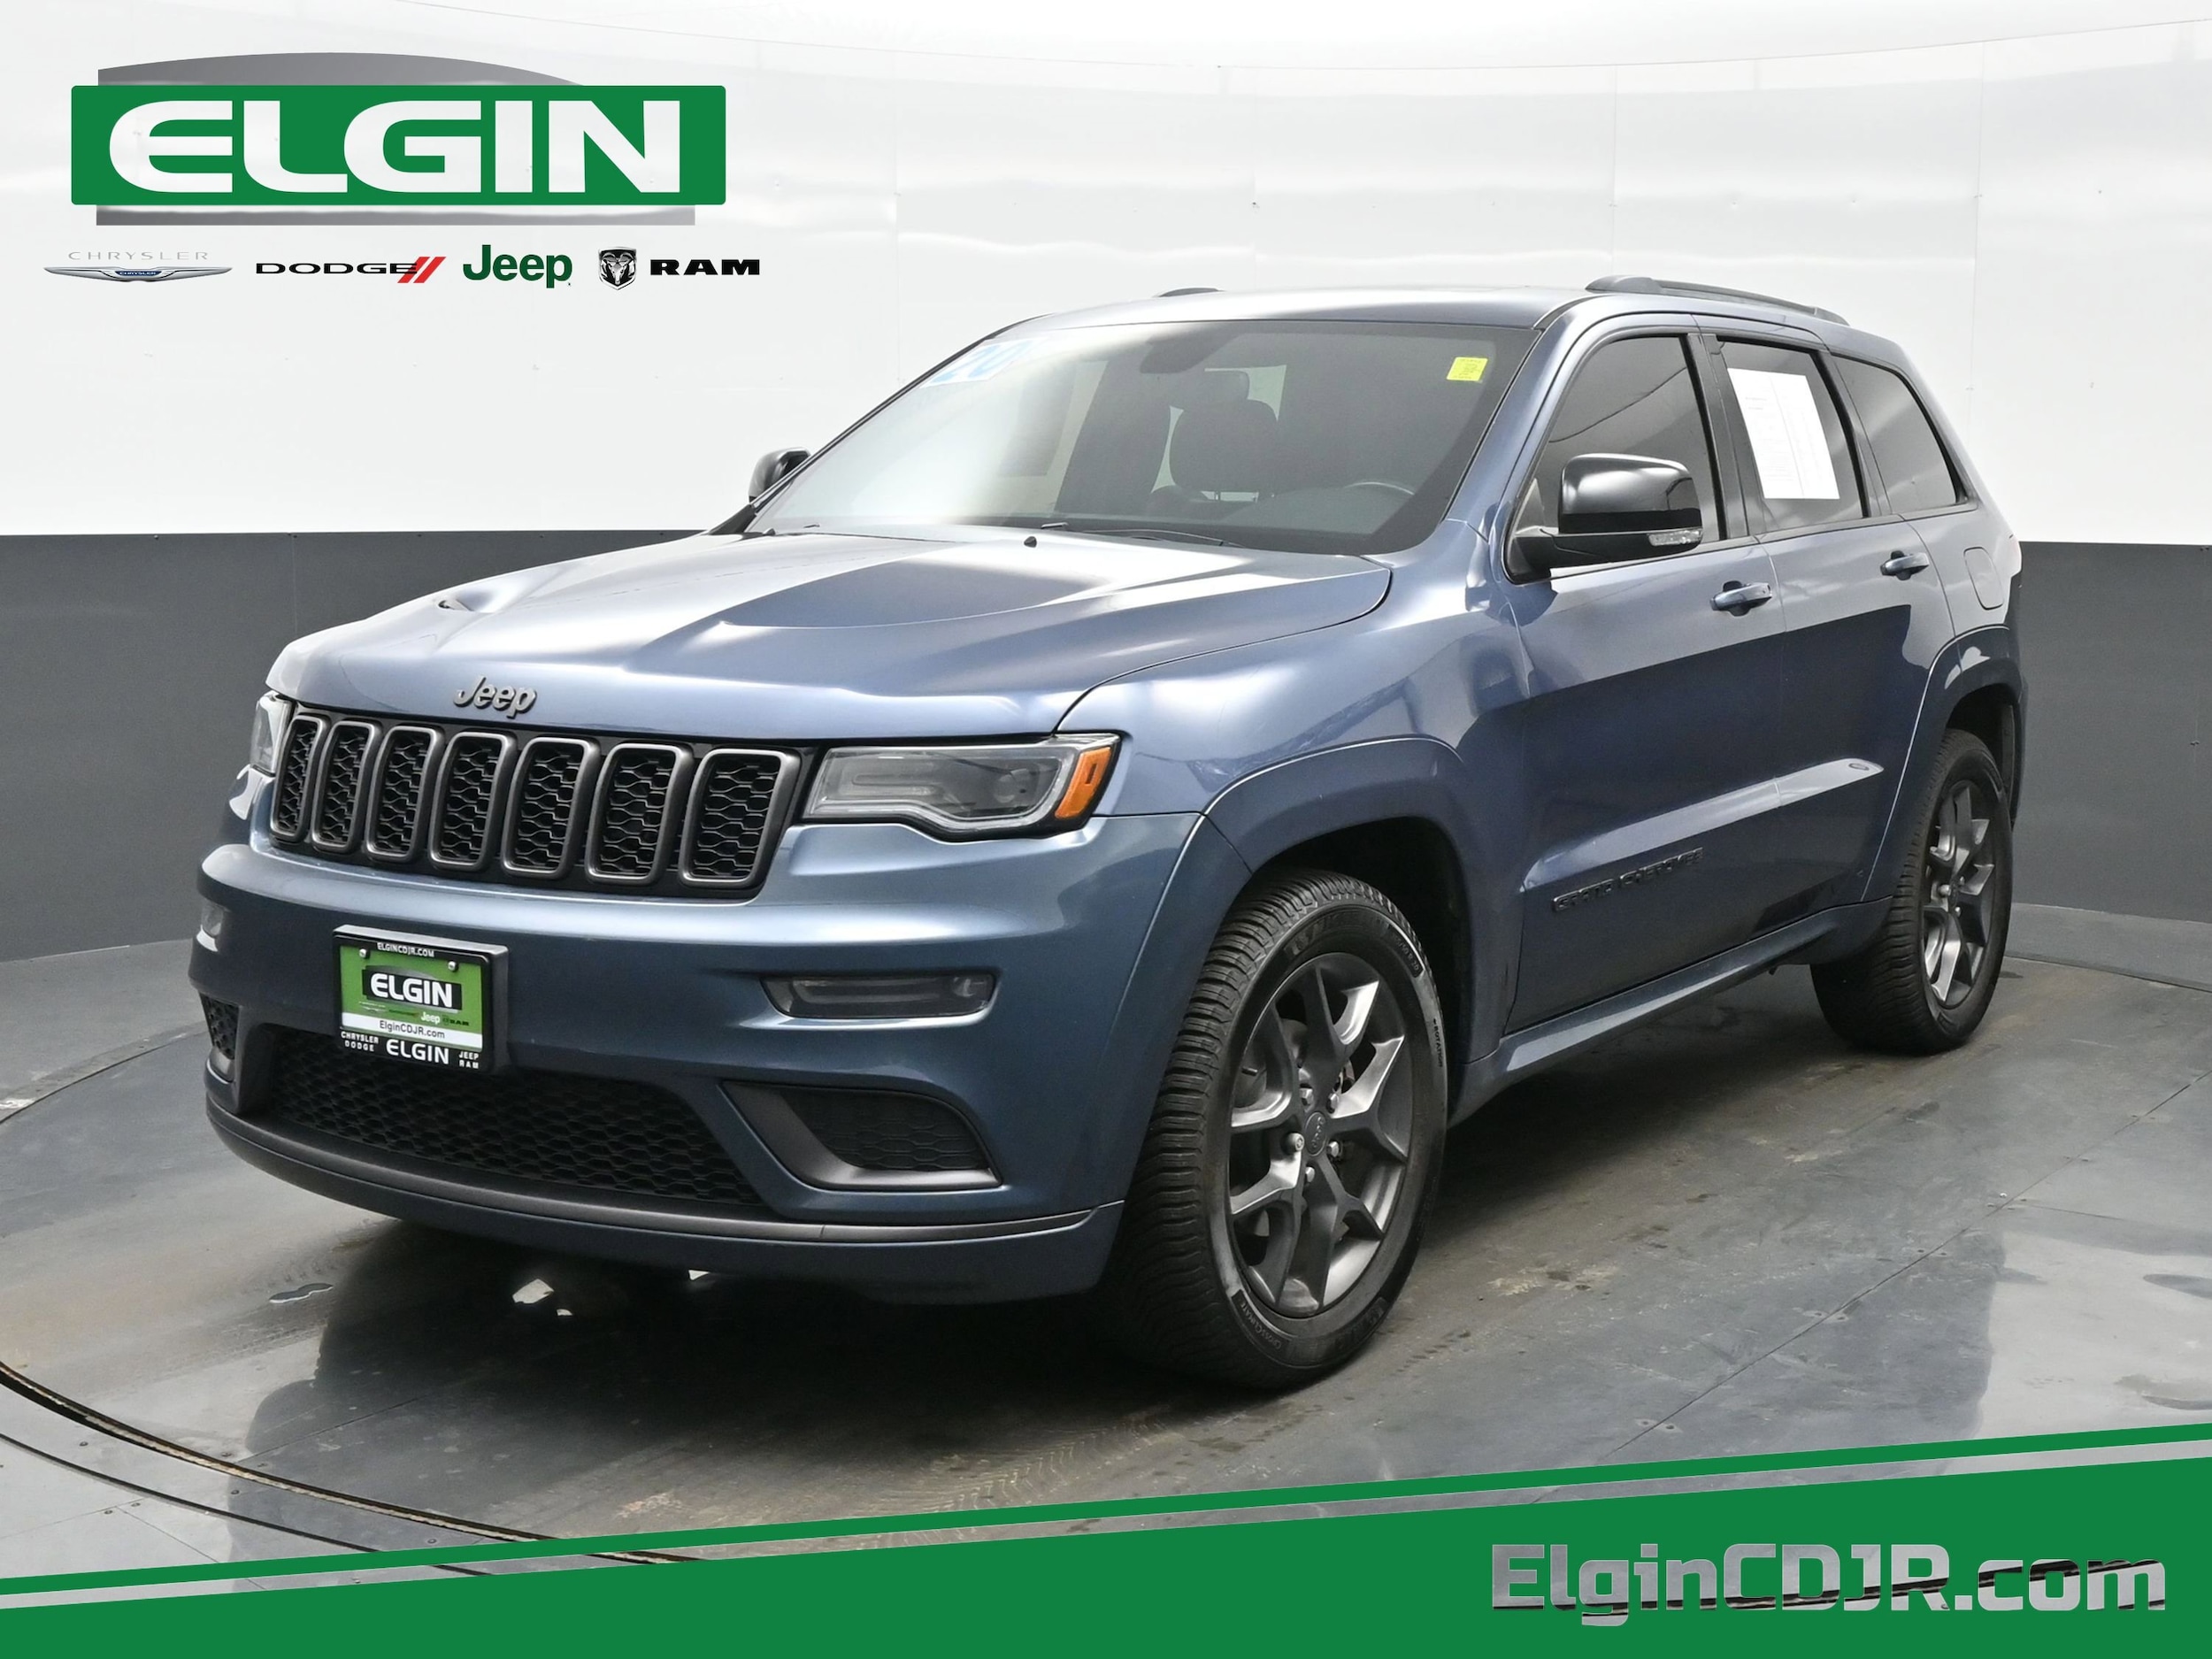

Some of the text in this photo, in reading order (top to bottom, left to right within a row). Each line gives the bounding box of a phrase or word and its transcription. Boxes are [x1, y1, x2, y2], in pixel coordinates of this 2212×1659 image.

[453, 675, 538, 719] Jeep
[377, 941, 435, 957] ELGINCDJR.COM
[370, 972, 453, 1008] ELGIN
[420, 1011, 441, 1025] Jeep
[341, 1030, 379, 1044] CHRYSLER
[380, 1019, 445, 1040] ElginCDJR.com
[344, 1041, 375, 1052] DODGE
[386, 1039, 449, 1064] ELGIN
[458, 1050, 480, 1061] JEEP
[458, 1061, 480, 1070] RAM
